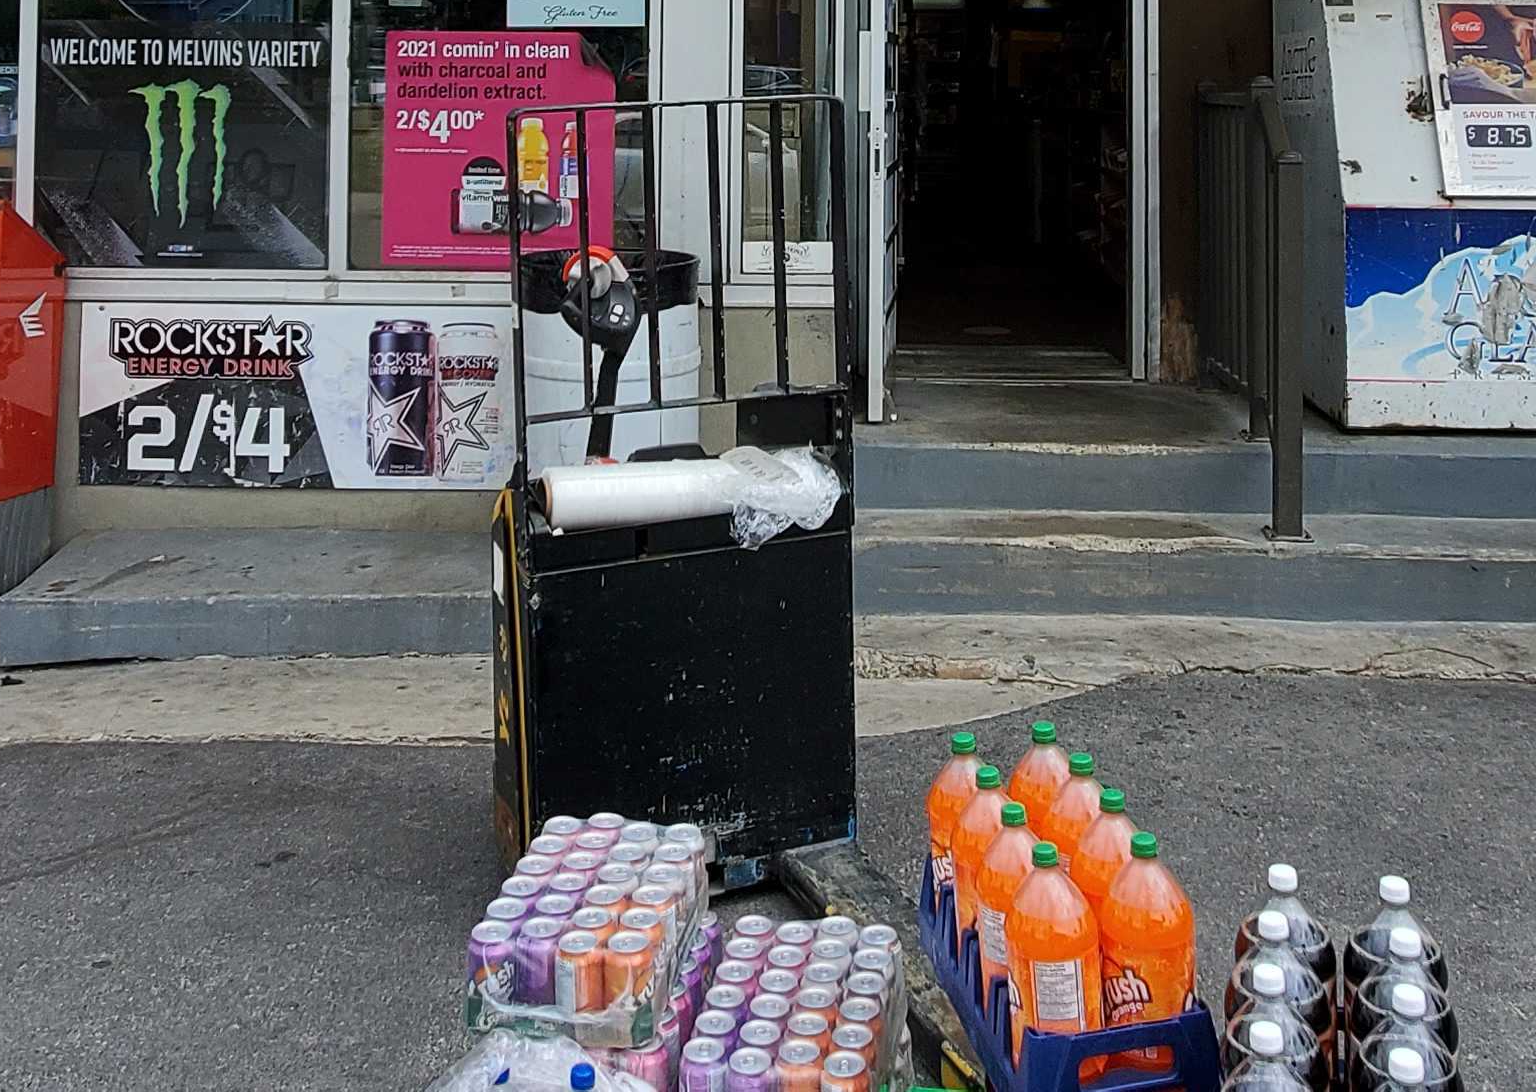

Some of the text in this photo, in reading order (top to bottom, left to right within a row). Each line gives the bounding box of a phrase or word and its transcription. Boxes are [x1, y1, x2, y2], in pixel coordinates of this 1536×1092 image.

[543, 4, 618, 25] Gluten Free
[50, 38, 321, 67] WELCOME TO MELVINS VARIETY
[397, 40, 570, 59] 2021 comin' in clean
[398, 61, 547, 79] with charcoal and
[397, 82, 547, 100] dandelion extract.
[1463, 110, 1504, 119] SAVOUR
[1507, 110, 1527, 119] THE
[1467, 126, 1527, 146] $ 8.75
[114, 320, 309, 356] ROCKSTAR
[128, 358, 293, 376] ENERGY DRINK
[127, 393, 291, 474] 2/$4
